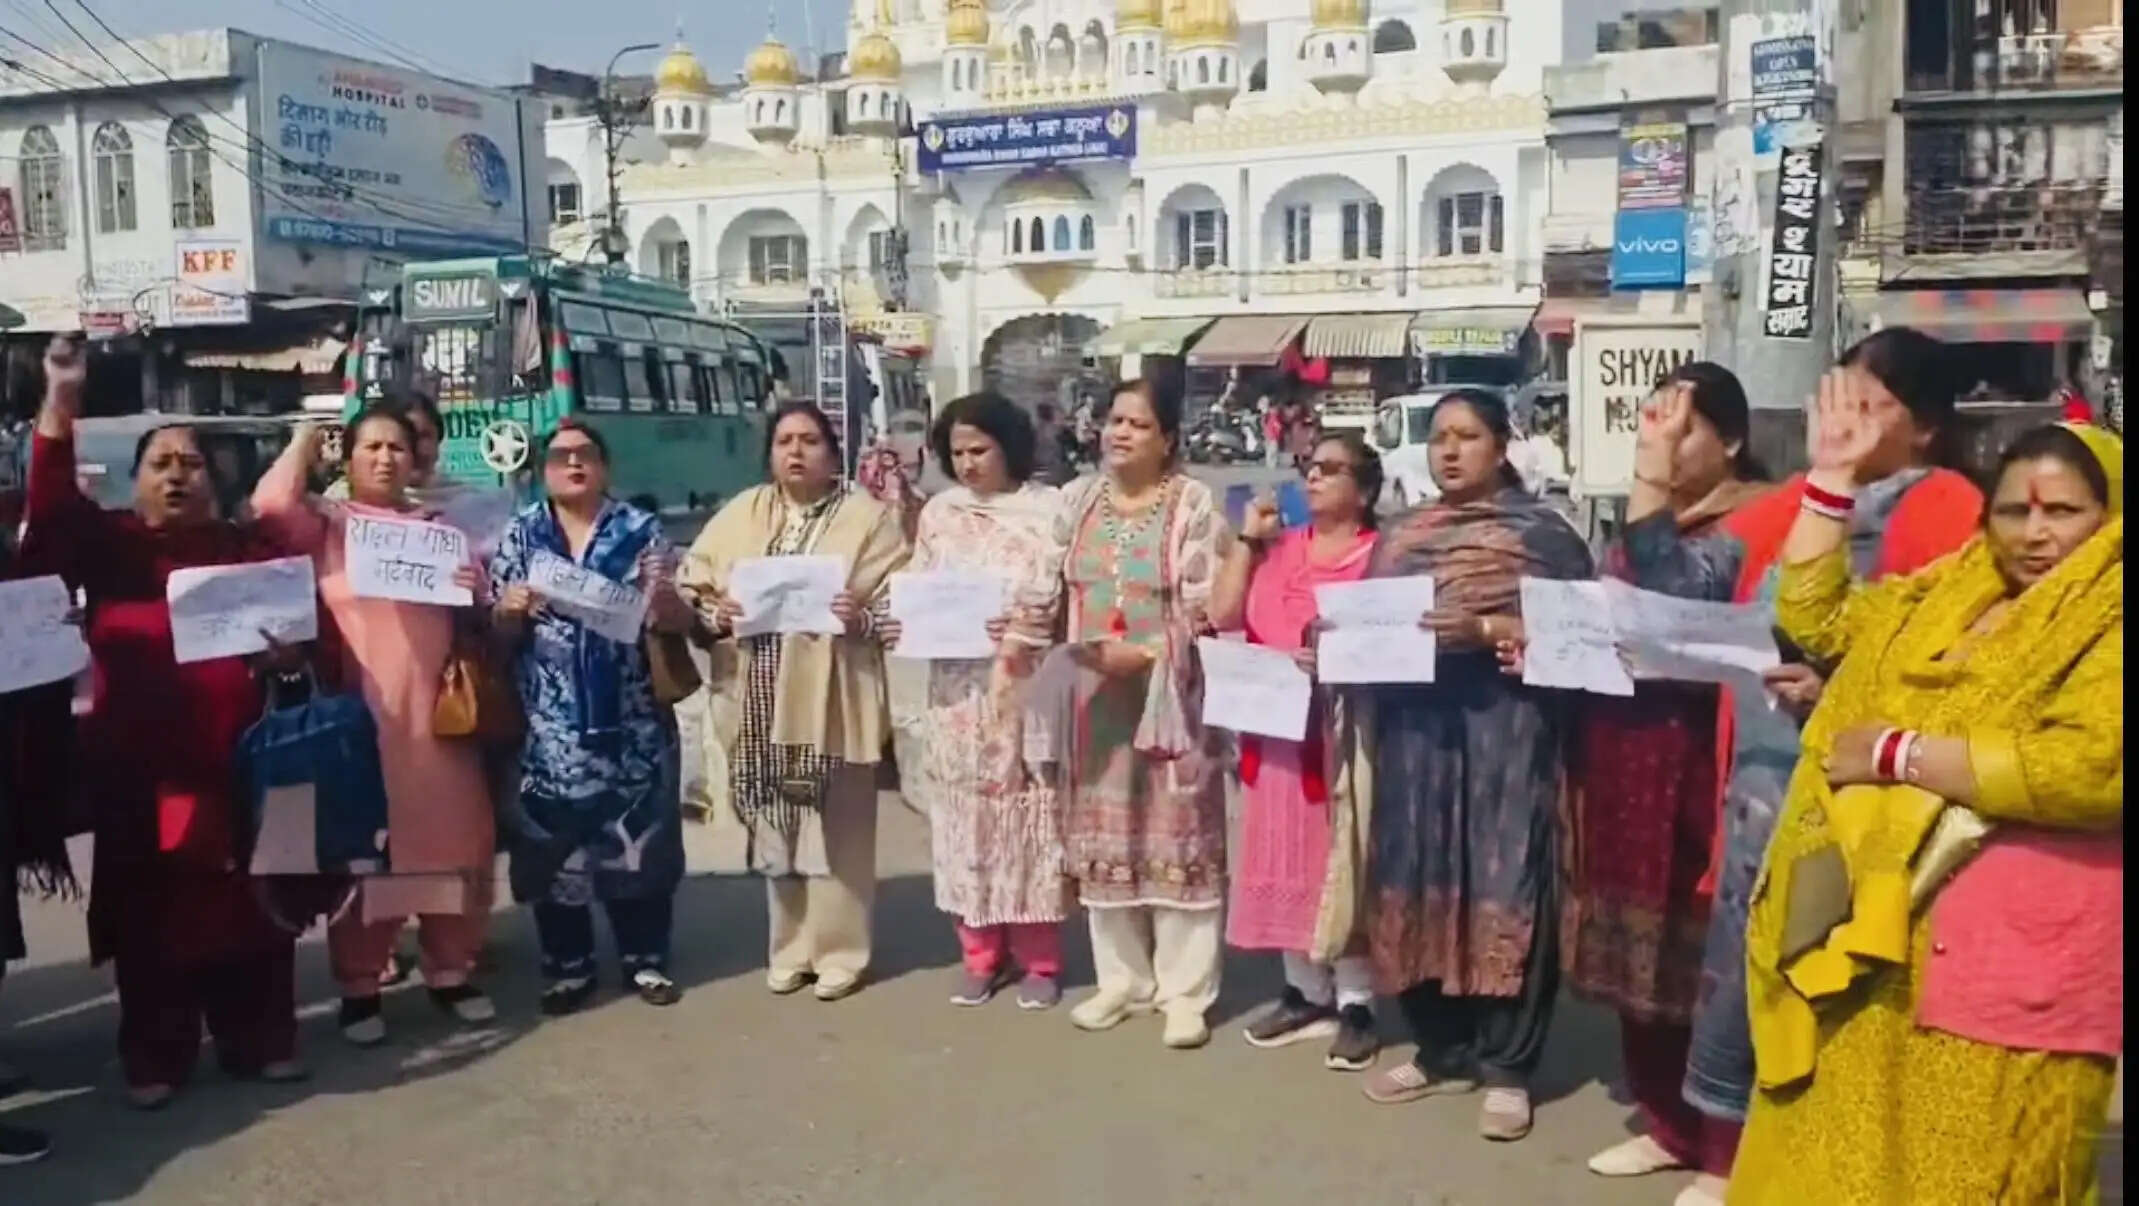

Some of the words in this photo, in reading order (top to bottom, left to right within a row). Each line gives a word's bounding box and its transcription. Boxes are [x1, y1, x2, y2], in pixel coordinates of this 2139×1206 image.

[332, 86, 406, 109] HOSPITAL
[1617, 235, 1680, 254] vivo
[182, 248, 237, 274] KFF
[1599, 347, 1695, 388] SHYAM
